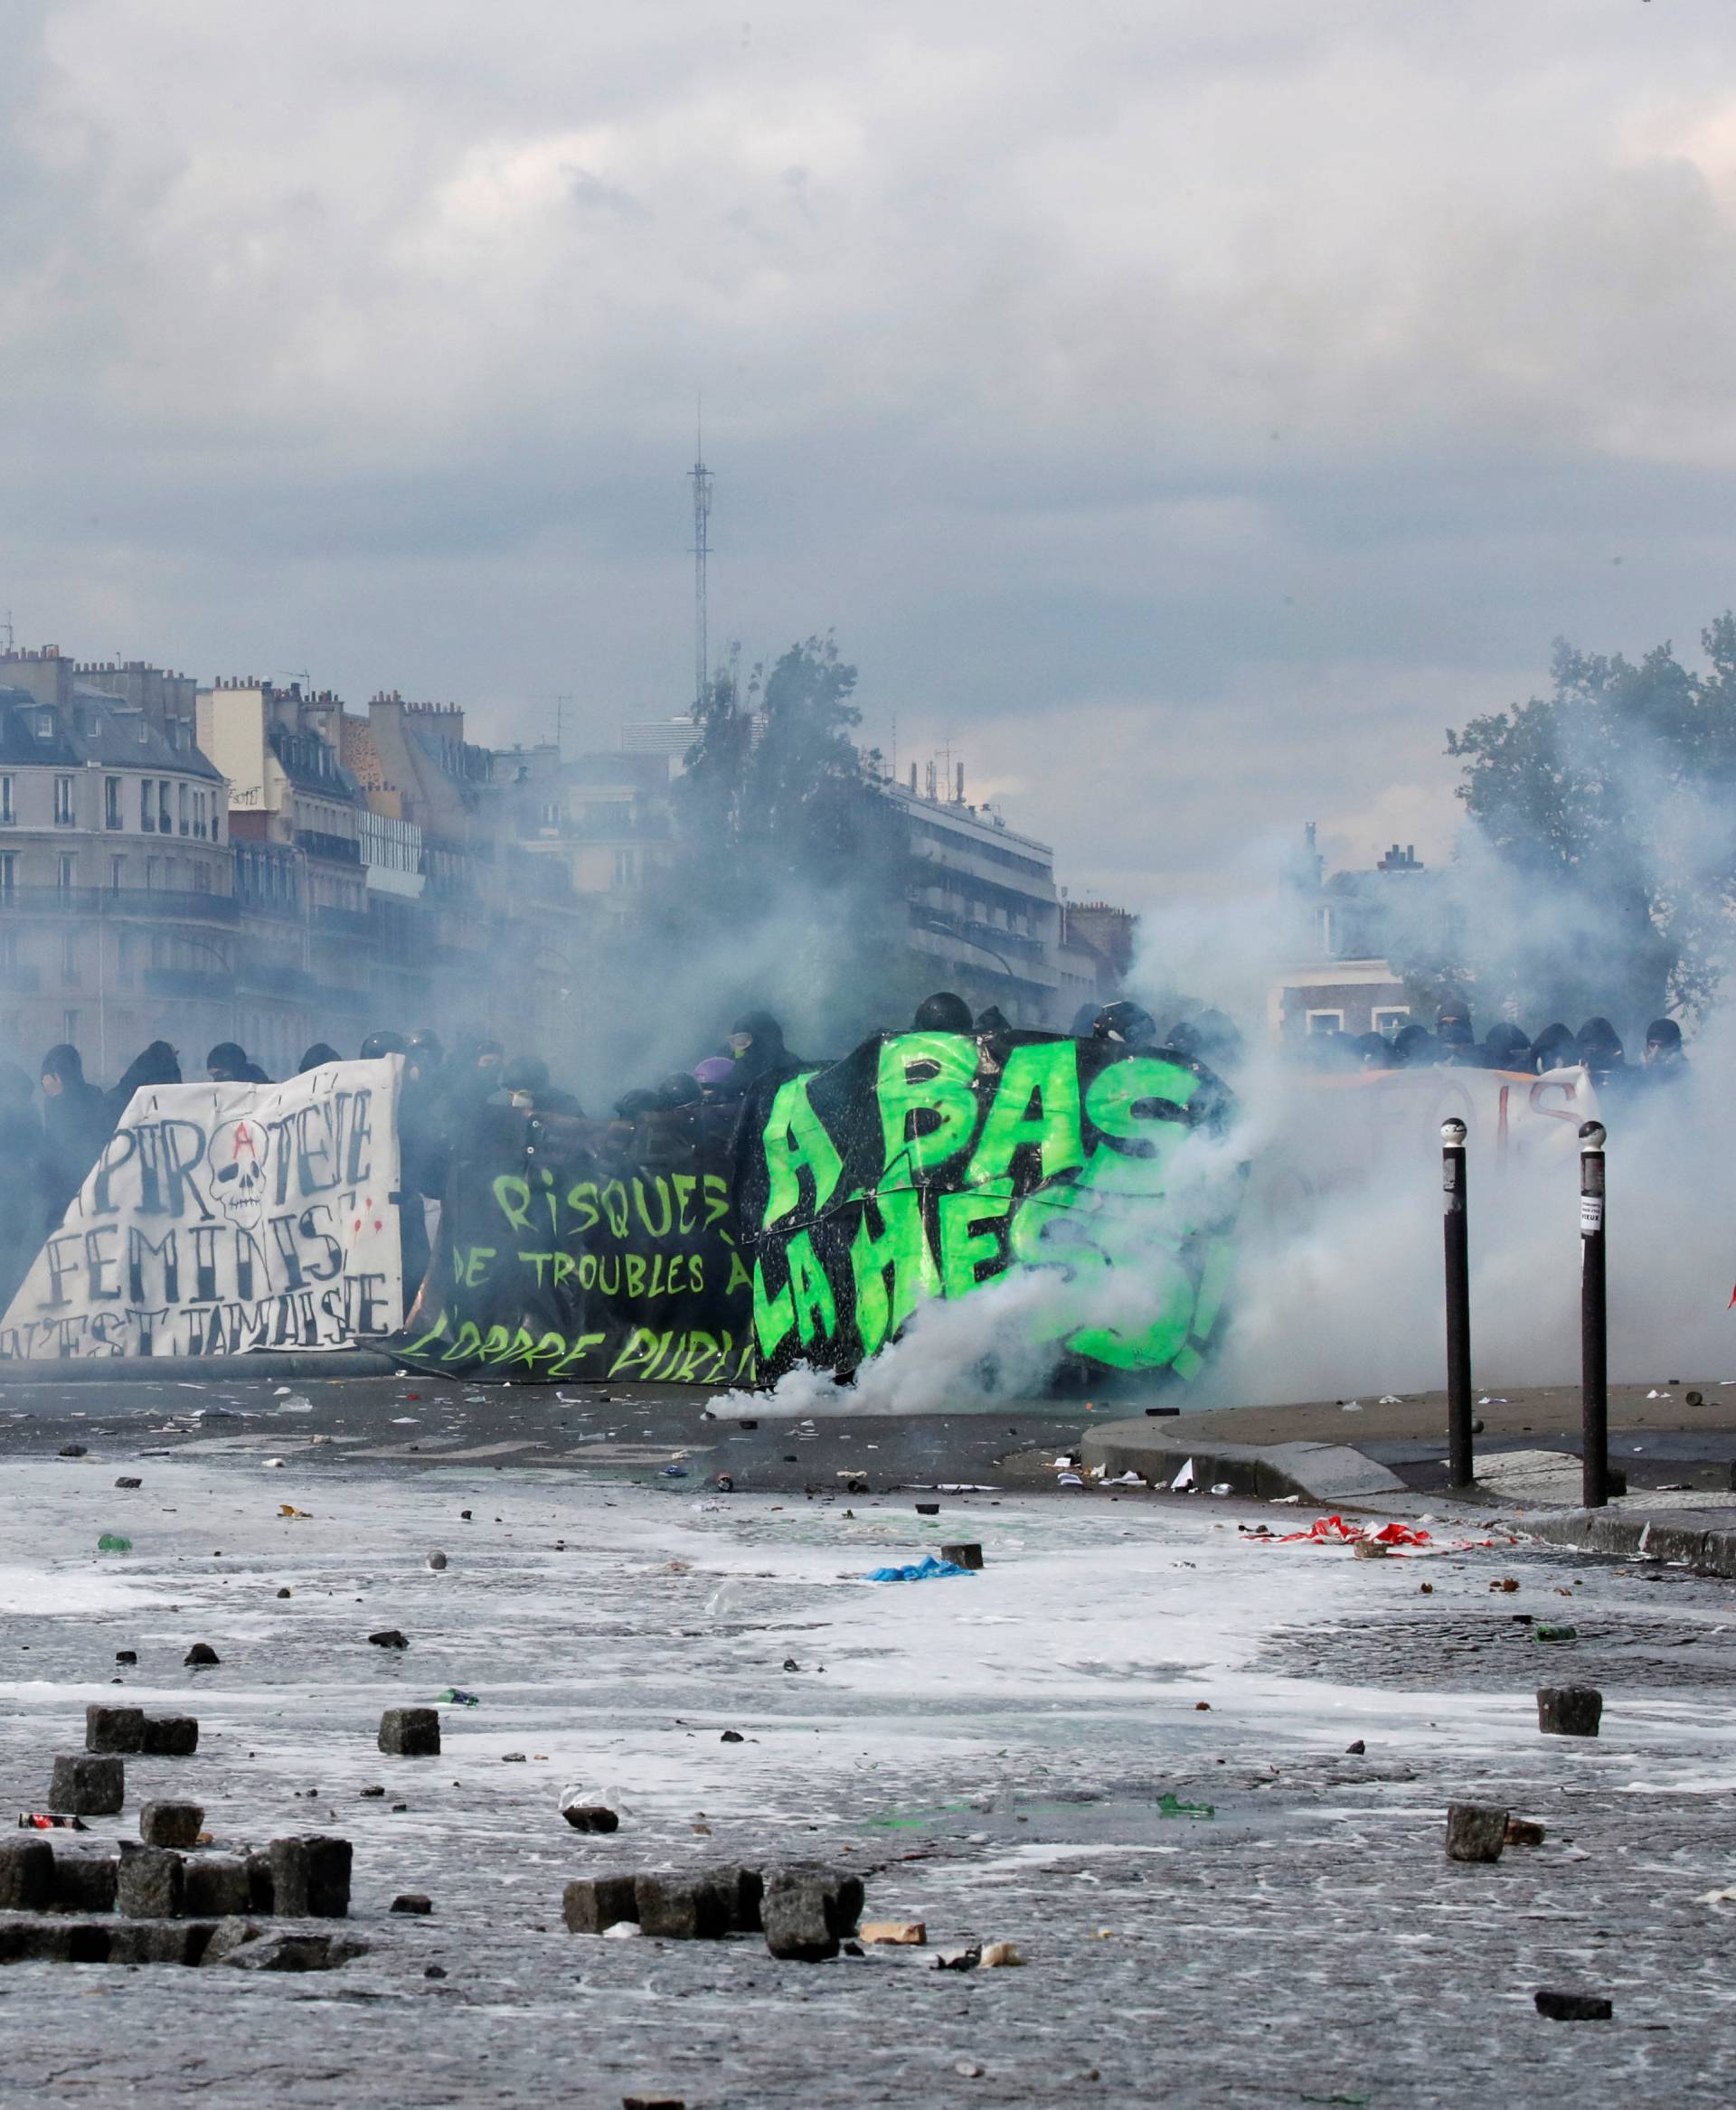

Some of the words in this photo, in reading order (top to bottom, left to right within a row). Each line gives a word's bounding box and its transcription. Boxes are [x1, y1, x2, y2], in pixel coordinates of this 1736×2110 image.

[876, 1031, 1203, 1195] BAS
[518, 1251, 704, 1298] TROUBLES
[753, 1228, 836, 1360] LA
